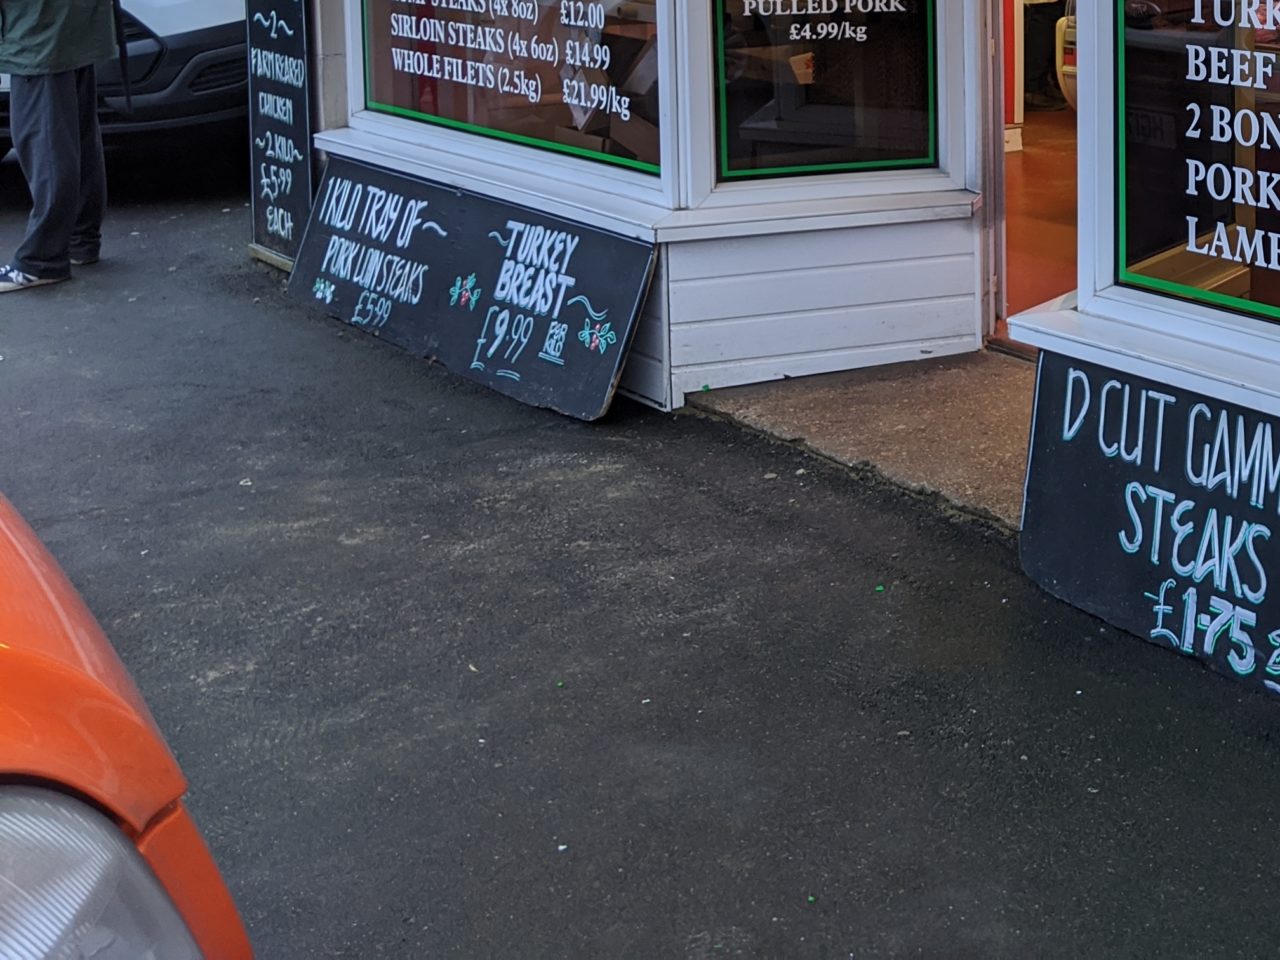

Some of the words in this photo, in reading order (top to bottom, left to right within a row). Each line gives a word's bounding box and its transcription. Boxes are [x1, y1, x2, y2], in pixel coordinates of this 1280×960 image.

[560, 0, 605, 29] £12.00
[789, 21, 868, 41] £4.99/kg
[391, 13, 445, 43] SIRLOIN
[448, 21, 505, 54] STEAKS
[508, 31, 528, 60] (4x
[531, 35, 559, 68] 6oz)
[565, 40, 611, 71] £14.99
[392, 48, 442, 79] WHOLE
[444, 55, 495, 89] FILETS
[498, 66, 542, 103] (2.5kg)
[562, 78, 631, 121] £21.99/kg
[1186, 44, 1276, 91] BEEF
[259, 92, 293, 126] CHICKEN
[1186, 104, 1201, 139] 2
[274, 136, 294, 164] KILO
[267, 205, 293, 240] EACH
[325, 177, 362, 232] KILO
[358, 185, 404, 244] TRAY
[397, 199, 428, 249] OF
[321, 235, 360, 281] PORK
[377, 255, 429, 305] STEAKS
[506, 220, 579, 274] TURKEY
[494, 259, 576, 320] BREAST
[543, 338, 564, 357] KILO
[548, 321, 568, 341] PER
[1063, 368, 1090, 440] D
[1099, 379, 1176, 473] CUT
[1119, 482, 1271, 604] STEAKS
